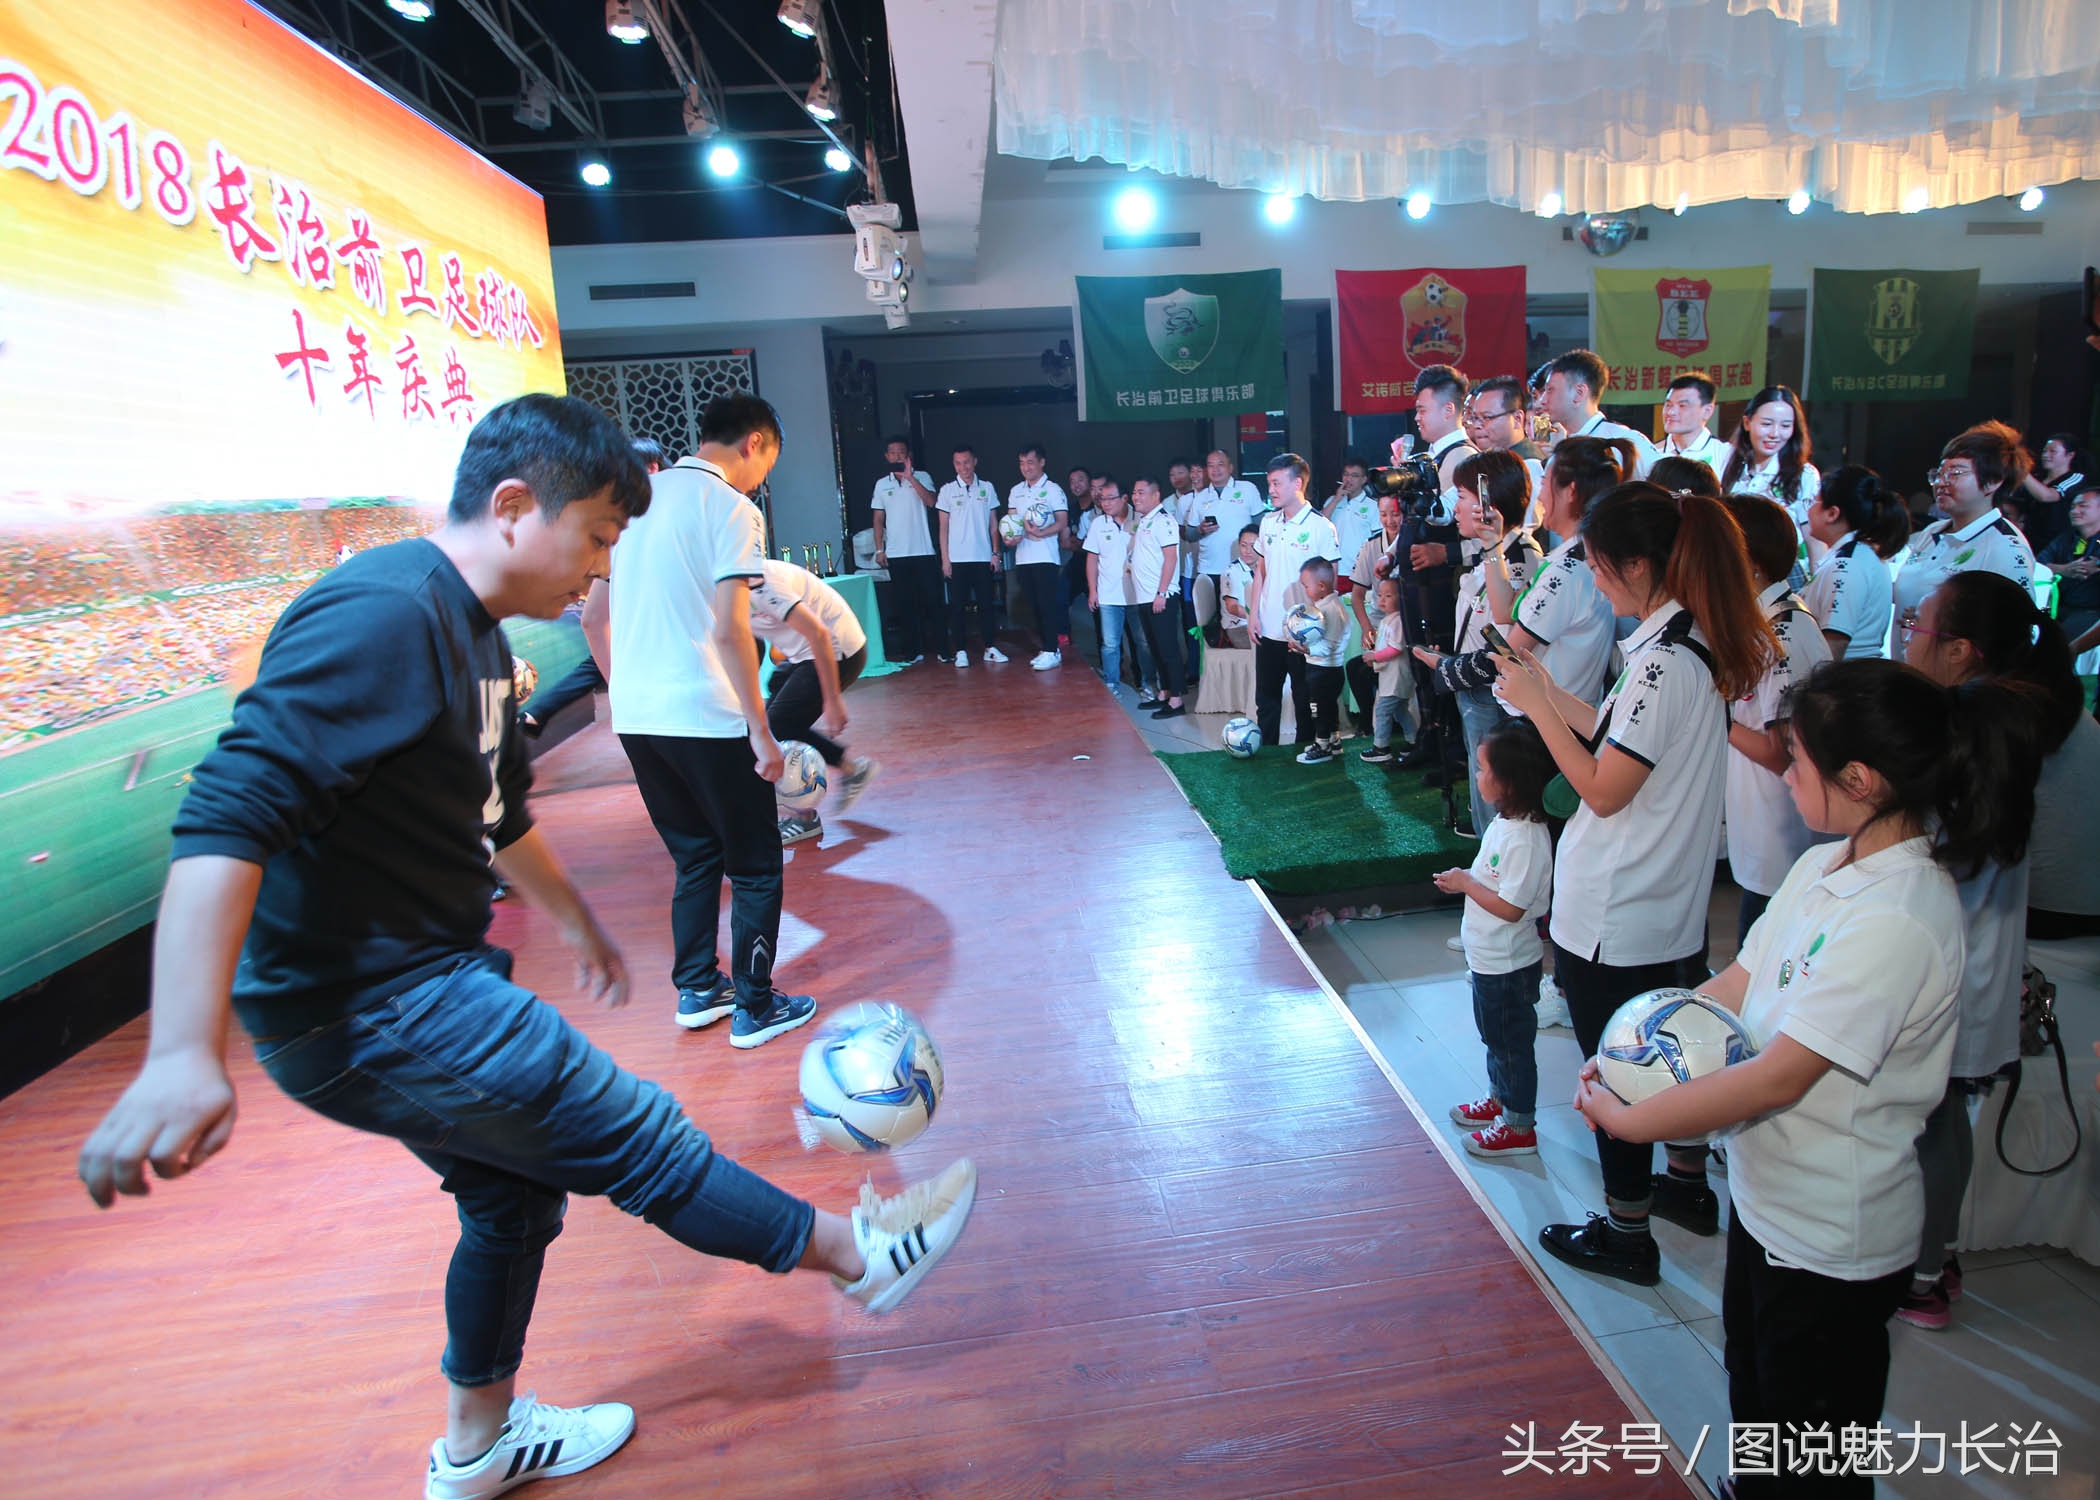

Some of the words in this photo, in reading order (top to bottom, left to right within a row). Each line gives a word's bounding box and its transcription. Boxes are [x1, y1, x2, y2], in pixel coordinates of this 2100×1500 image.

[275, 308, 474, 424] 十年庆典
[1115, 383, 1255, 407] 长治前卫足球俱乐部
